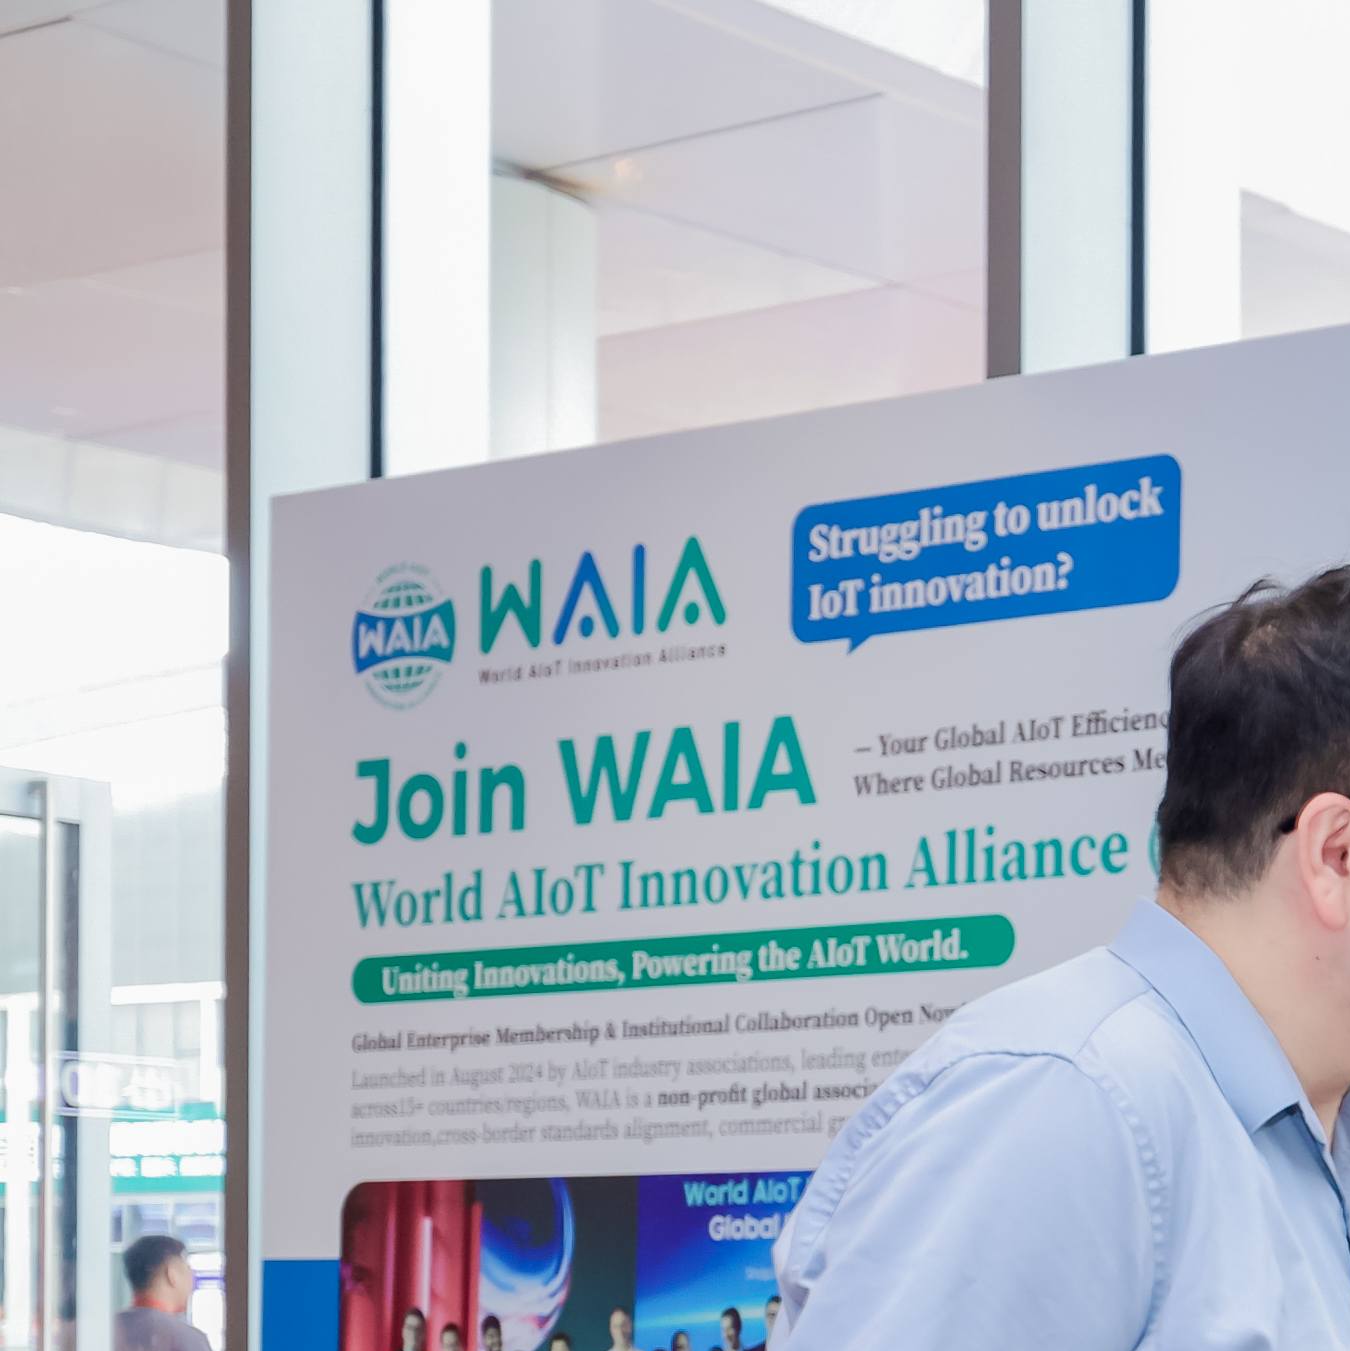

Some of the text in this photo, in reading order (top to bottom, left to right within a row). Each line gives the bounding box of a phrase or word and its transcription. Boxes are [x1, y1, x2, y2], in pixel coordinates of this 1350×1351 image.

[808, 476, 1164, 563] Struggling to unlock
[480, 536, 726, 654] WAIA
[808, 551, 1073, 621] IoT innovation?
[359, 613, 449, 659] WAIA
[479, 643, 728, 684] World AIoT Innovation Alliance
[879, 733, 929, 757] Your
[934, 720, 1005, 751] Global
[1013, 716, 1064, 742] AIoT
[352, 716, 817, 845] Join WAIA
[854, 774, 923, 797] Where
[931, 760, 1001, 790] Global
[1010, 757, 1124, 783] Resources
[352, 868, 483, 929] World
[497, 862, 604, 920] AIoT
[617, 839, 889, 911] Innovation
[904, 824, 1128, 888] Alliance
[382, 928, 969, 998] Uniting Innovations, Powering the AIoT World.
[352, 1032, 401, 1053] Global
[407, 1026, 490, 1053] Enterprise
[496, 1021, 599, 1049] Membership
[622, 1012, 730, 1040] Institutional
[735, 1008, 859, 1033] Collaboration
[865, 1007, 913, 1031] Open
[352, 1067, 425, 1090] Launched
[431, 1066, 445, 1085] in
[450, 1064, 503, 1088] August
[547, 1060, 567, 1086] by
[572, 1060, 608, 1081] AIoT
[613, 1056, 681, 1083] industry
[686, 1050, 795, 1076] associations,
[801, 1046, 866, 1074] leading
[576, 1090, 620, 1108] WAIA
[626, 1089, 639, 1107] is
[752, 1080, 807, 1107] global
[542, 1119, 618, 1143] standards
[719, 1112, 822, 1138] commercial
[683, 1176, 803, 1207] World AIoT
[709, 1213, 780, 1241] Global
